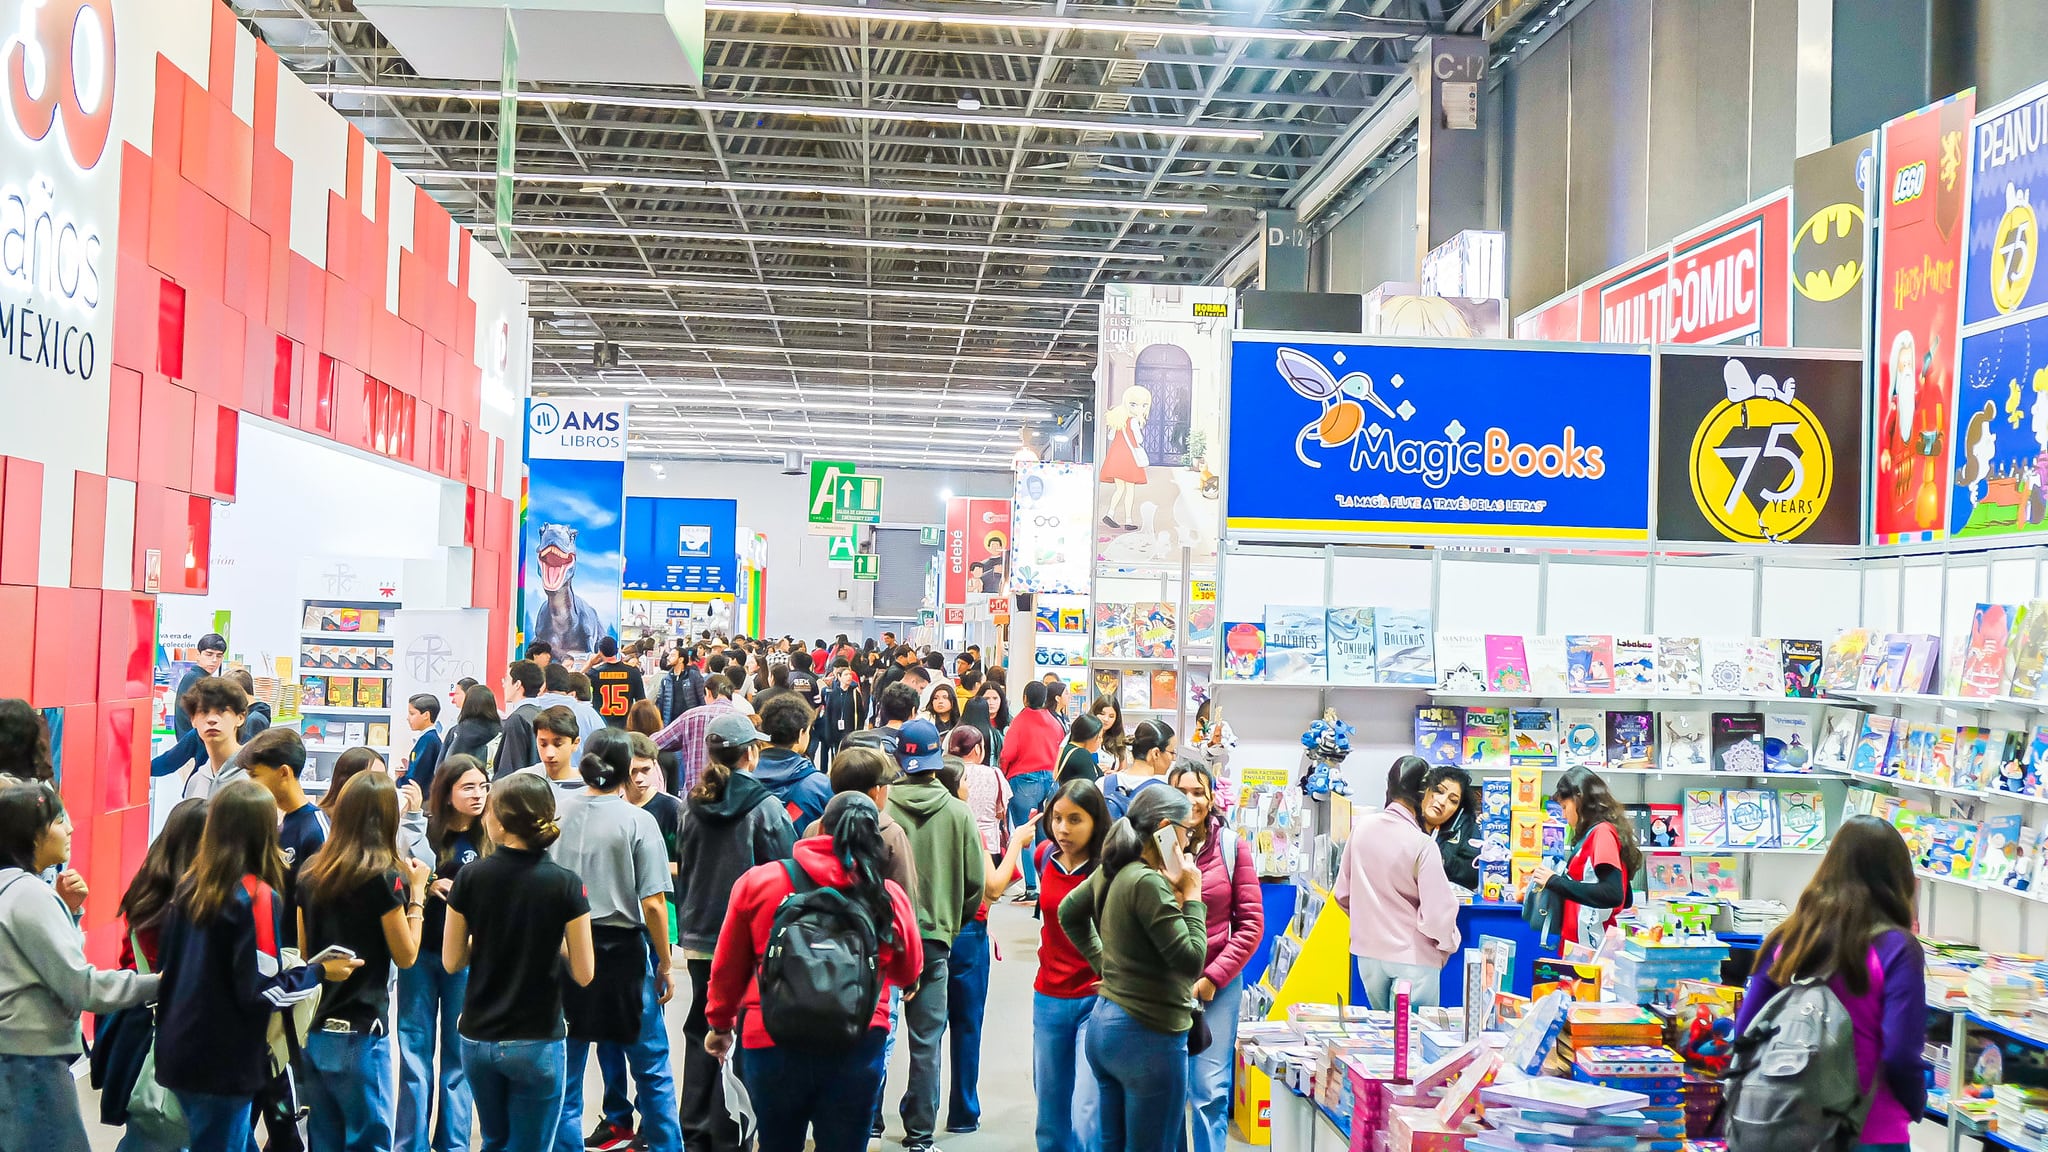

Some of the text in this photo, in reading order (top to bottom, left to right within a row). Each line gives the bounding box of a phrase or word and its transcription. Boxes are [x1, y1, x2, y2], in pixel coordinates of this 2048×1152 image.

[1434, 53, 1485, 80] C-12
[1894, 161, 1925, 204] LEGO
[3, 181, 101, 310] años
[1268, 227, 1304, 247] D-12
[2000, 221, 2030, 291] 75
[1893, 254, 1954, 310] Harry Potter
[1194, 303, 1227, 313] NORMA
[0, 298, 95, 381] MÉXICO
[1104, 328, 1137, 344] LOBO
[562, 411, 620, 432] AMS
[560, 434, 620, 449] LIBROS
[1350, 426, 1605, 488] MagicBooks
[1713, 422, 1804, 516] 75
[1391, 496, 1421, 509] FLUYE
[1423, 498, 1432, 509] A
[1433, 496, 1469, 510] TRAVÉS
[1772, 500, 1813, 514] YEARS
[950, 529, 963, 574] edebé
[182, 632, 192, 640] de
[447, 659, 475, 678] 70
[600, 684, 629, 716] 15
[1466, 714, 1496, 724] PIXEL
